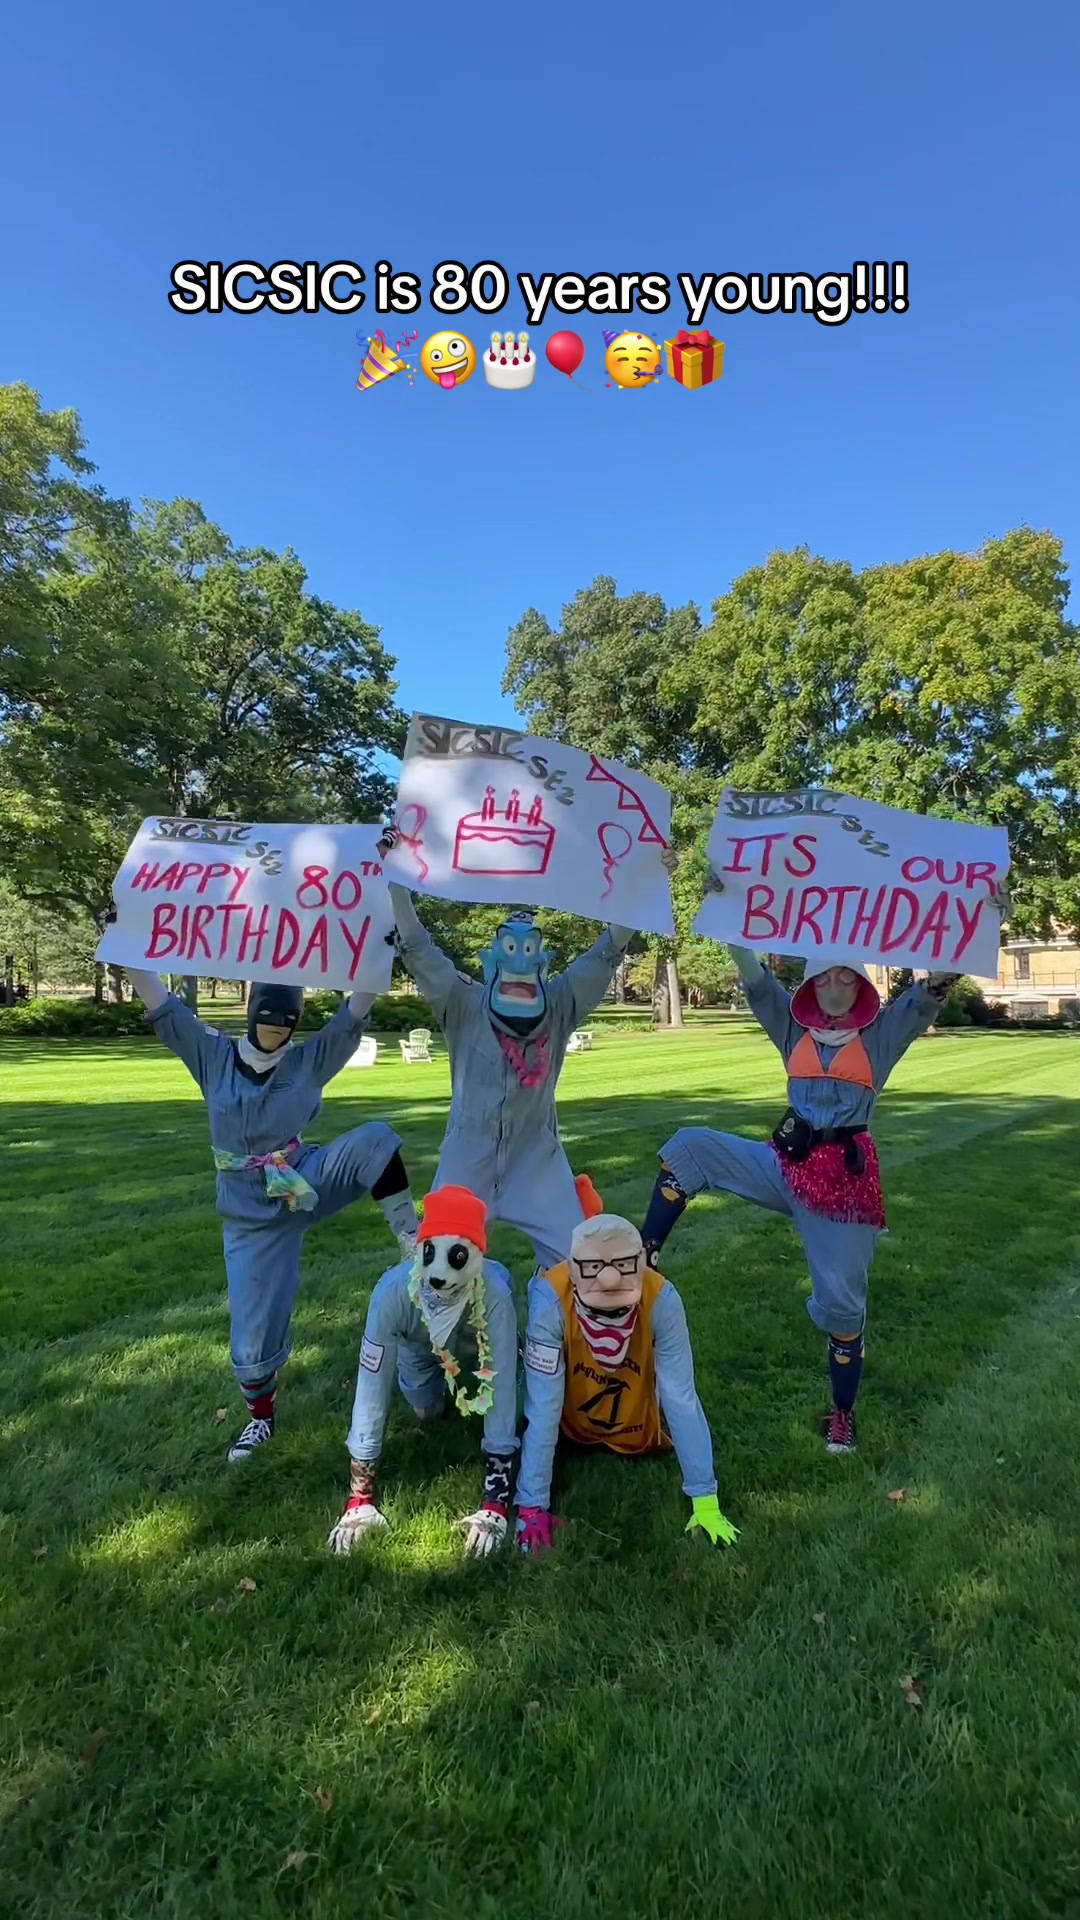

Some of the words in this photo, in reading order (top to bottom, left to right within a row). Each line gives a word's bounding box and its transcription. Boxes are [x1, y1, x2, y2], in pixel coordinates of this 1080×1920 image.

[416, 715, 525, 763] SICSIC
[724, 789, 843, 820] SICSIC
[151, 818, 253, 846] SICSIC
[722, 831, 818, 878] ITS
[131, 861, 250, 903] HAPPY
[901, 855, 998, 898] OUR
[145, 902, 372, 982] BIRTHDAY
[741, 884, 984, 965] BIRTHDAY
